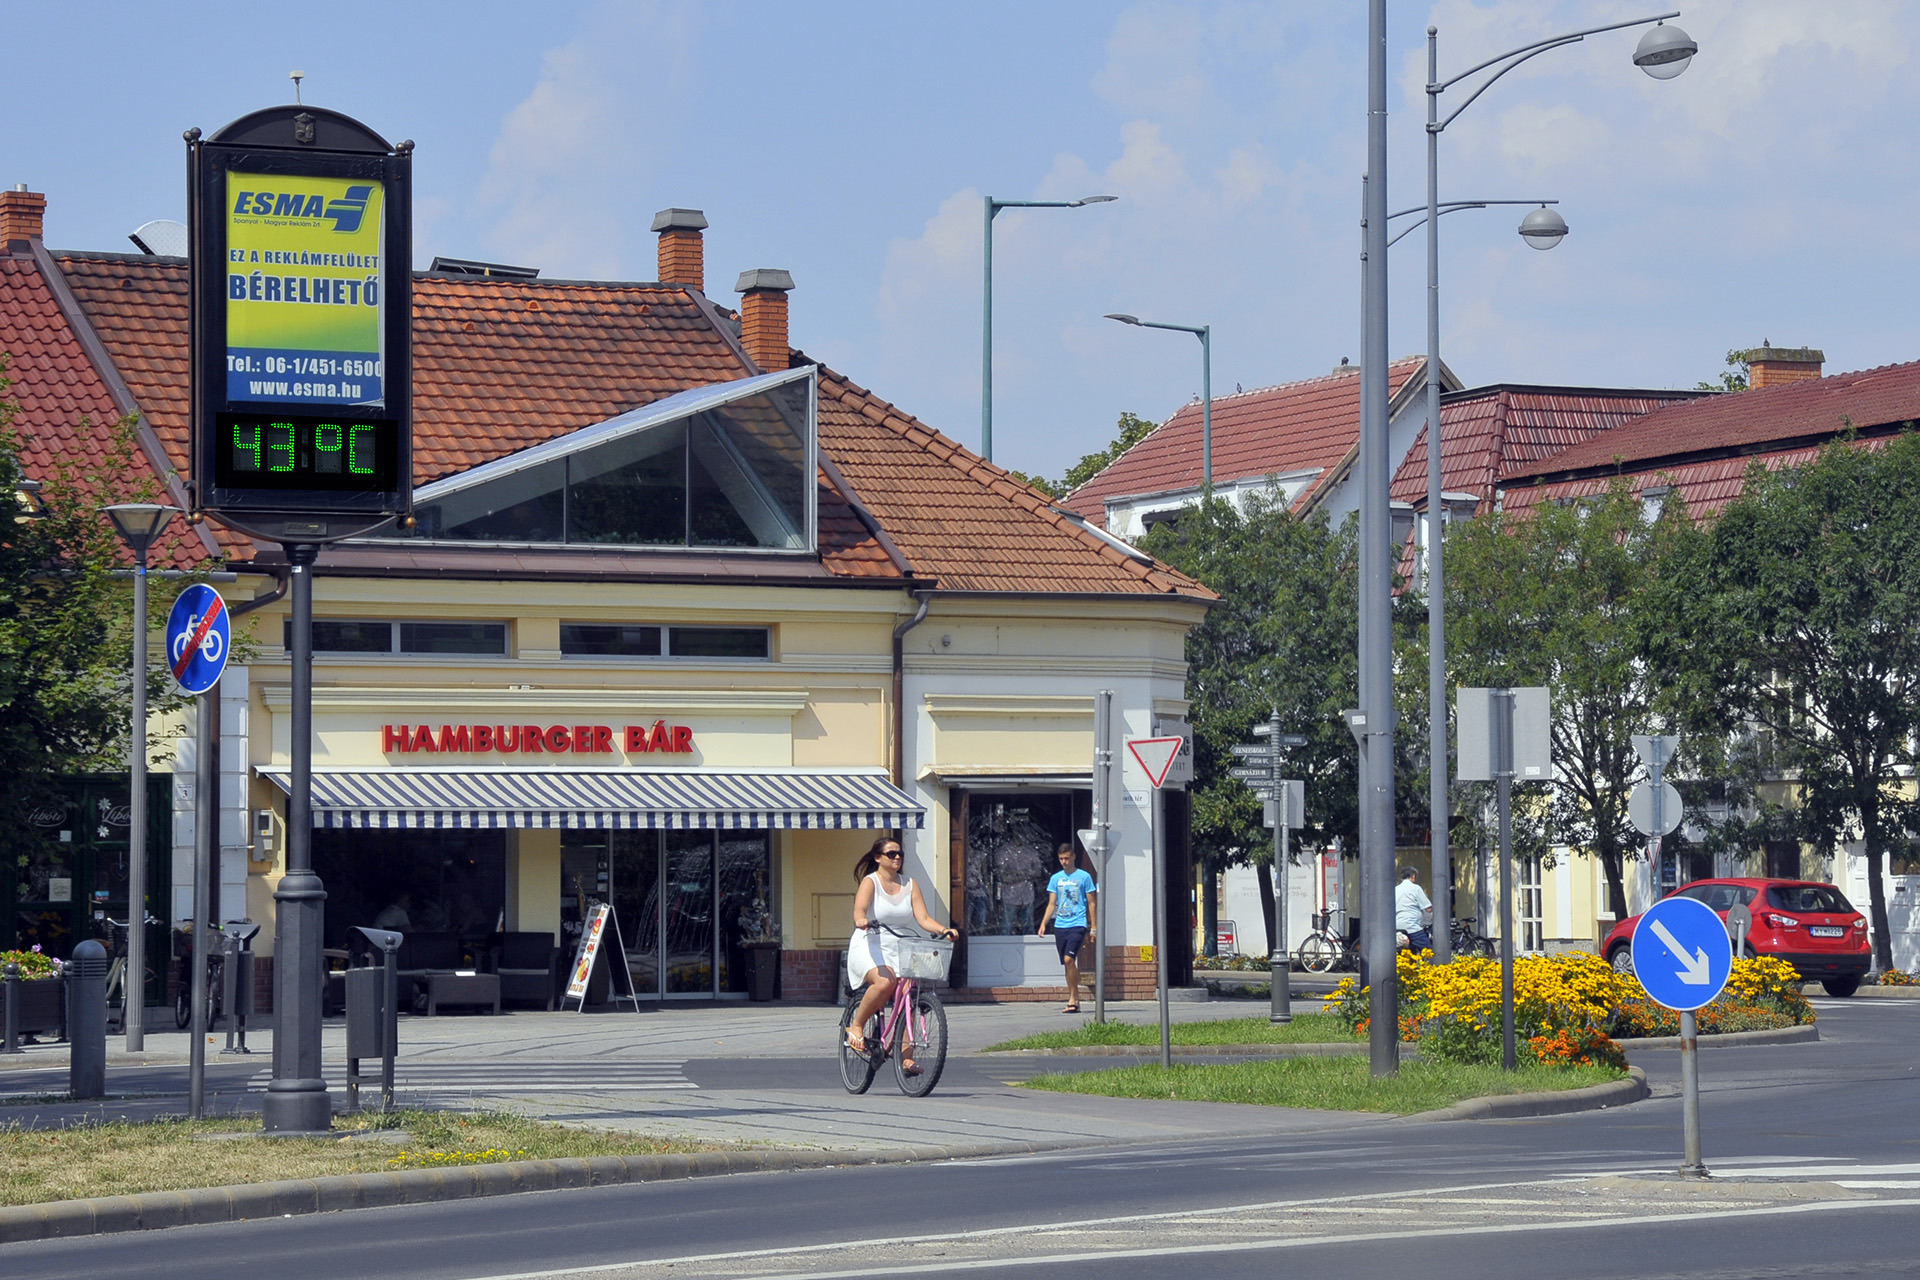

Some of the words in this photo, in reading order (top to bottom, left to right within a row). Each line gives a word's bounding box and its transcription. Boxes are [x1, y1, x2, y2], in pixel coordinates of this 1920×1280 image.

[233, 191, 324, 218] ESMA
[233, 217, 259, 225] Spanyol
[264, 219, 288, 227] Magyar
[230, 249, 245, 263] EZ
[250, 250, 259, 263] A
[264, 250, 378, 269] REKLÁMFELÜLET
[228, 270, 378, 306] BÉRELHETŐ
[227, 355, 261, 372] Tel.:
[249, 381, 361, 398] www.esma.hu
[382, 724, 613, 753] HAMBURGER
[623, 720, 694, 753] BÁR
